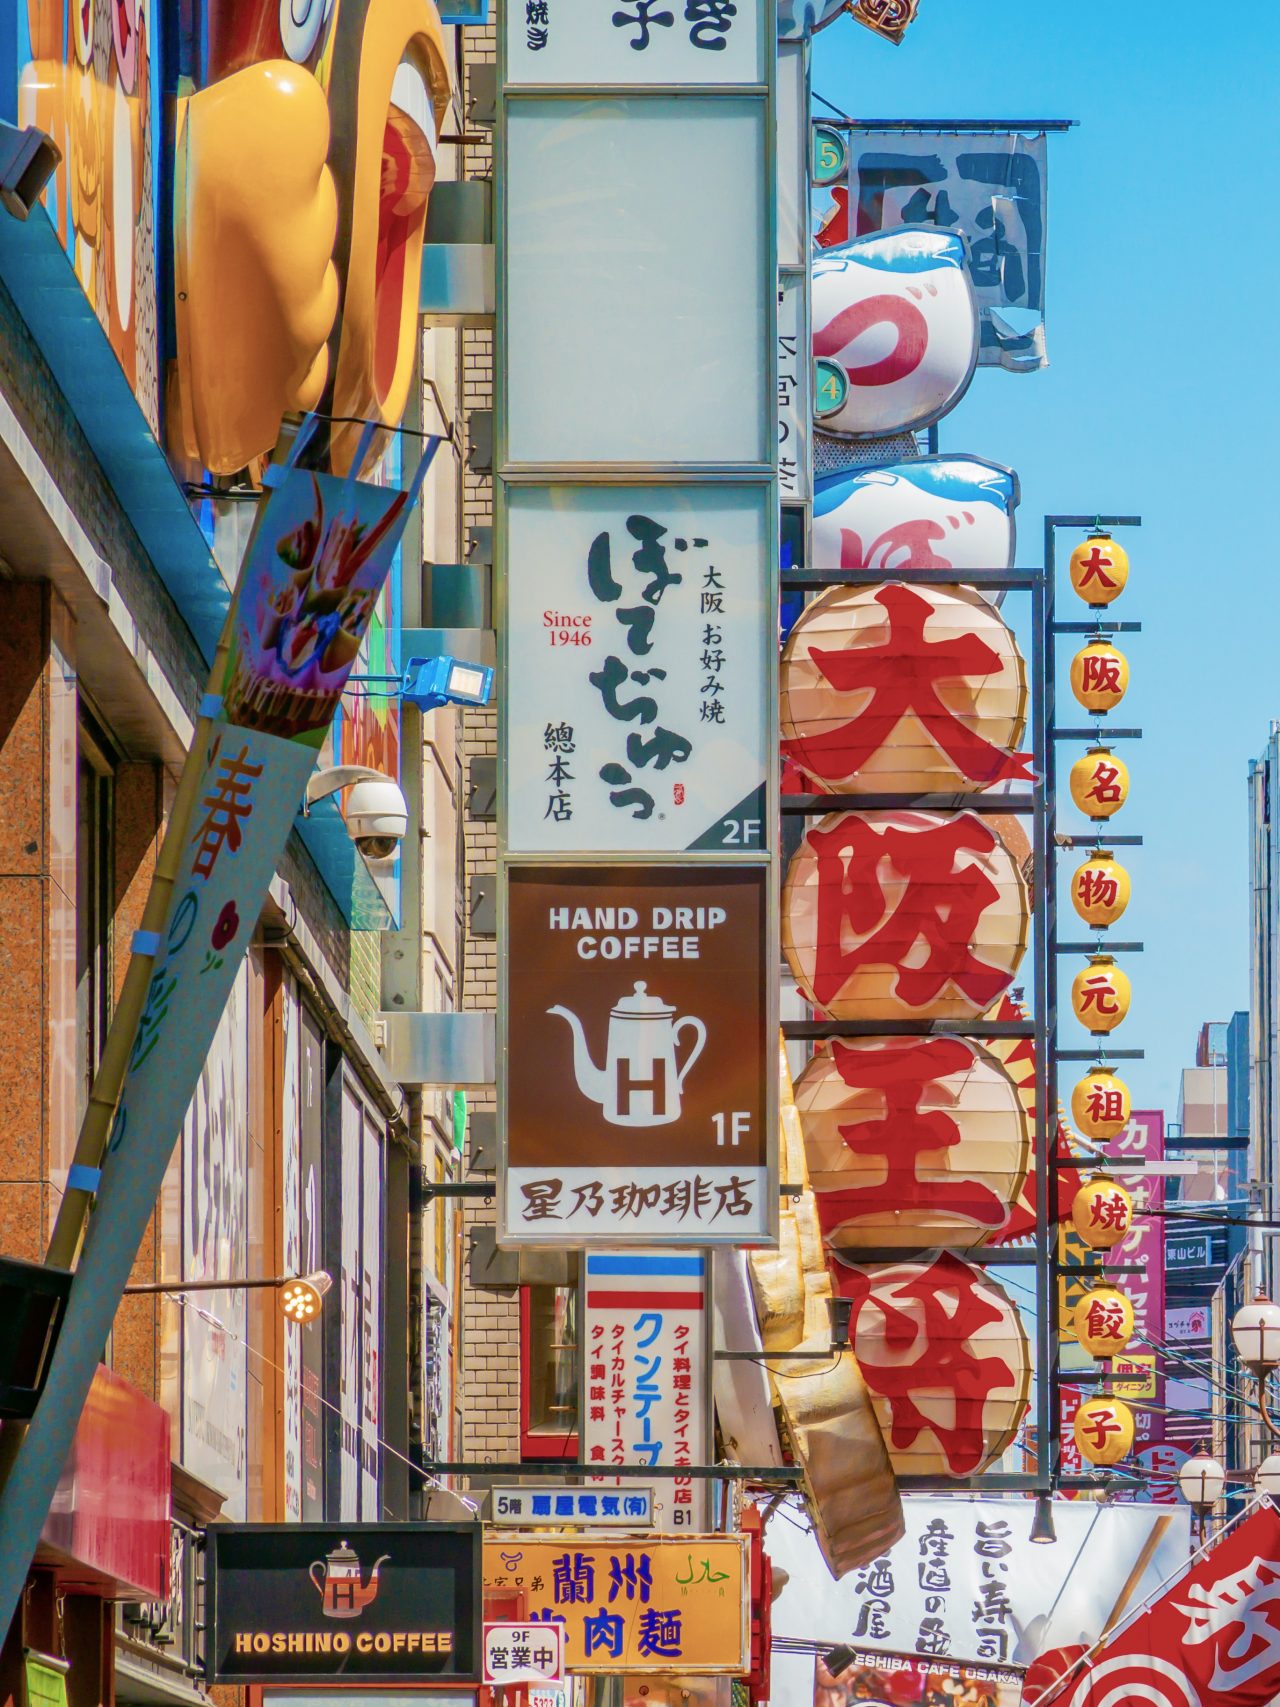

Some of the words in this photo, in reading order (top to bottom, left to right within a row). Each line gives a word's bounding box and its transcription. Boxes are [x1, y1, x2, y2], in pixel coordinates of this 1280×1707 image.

[819, 142, 838, 170] 5
[822, 375, 840, 400] 4
[700, 565, 727, 614] 大阪
[543, 611, 592, 628] Since
[549, 630, 592, 647] 1946
[587, 514, 709, 820] ぼてぢゅう
[699, 623, 727, 725] お好み焼
[543, 721, 577, 822] 總本店
[721, 819, 761, 845] 2F
[549, 906, 639, 931] HAND
[651, 906, 728, 931] DRIP
[576, 936, 700, 960] COFFEE
[1077, 547, 1128, 1451] 大阪名物元祖焼餃子
[616, 1057, 666, 1116] H
[711, 1111, 751, 1146] 1F
[519, 1173, 758, 1225] 星乃珈琲店
[589, 1324, 606, 1423] タイ調味料
[632, 1313, 664, 1467] クンテープ
[497, 1496, 522, 1515] 5階
[673, 1509, 692, 1526] B1
[552, 1552, 653, 1604] 蘭州
[332, 1583, 354, 1610] H
[851, 1549, 895, 1640] 酒屋
[235, 1632, 350, 1653] HOSHINO
[356, 1632, 453, 1653] COFFEE
[512, 1631, 530, 1644] 9F
[490, 1647, 554, 1670] 営業中
[853, 1655, 912, 1673] ESHIBA
[917, 1661, 960, 1678] CAFE
[965, 1668, 1019, 1686] OSAKA
